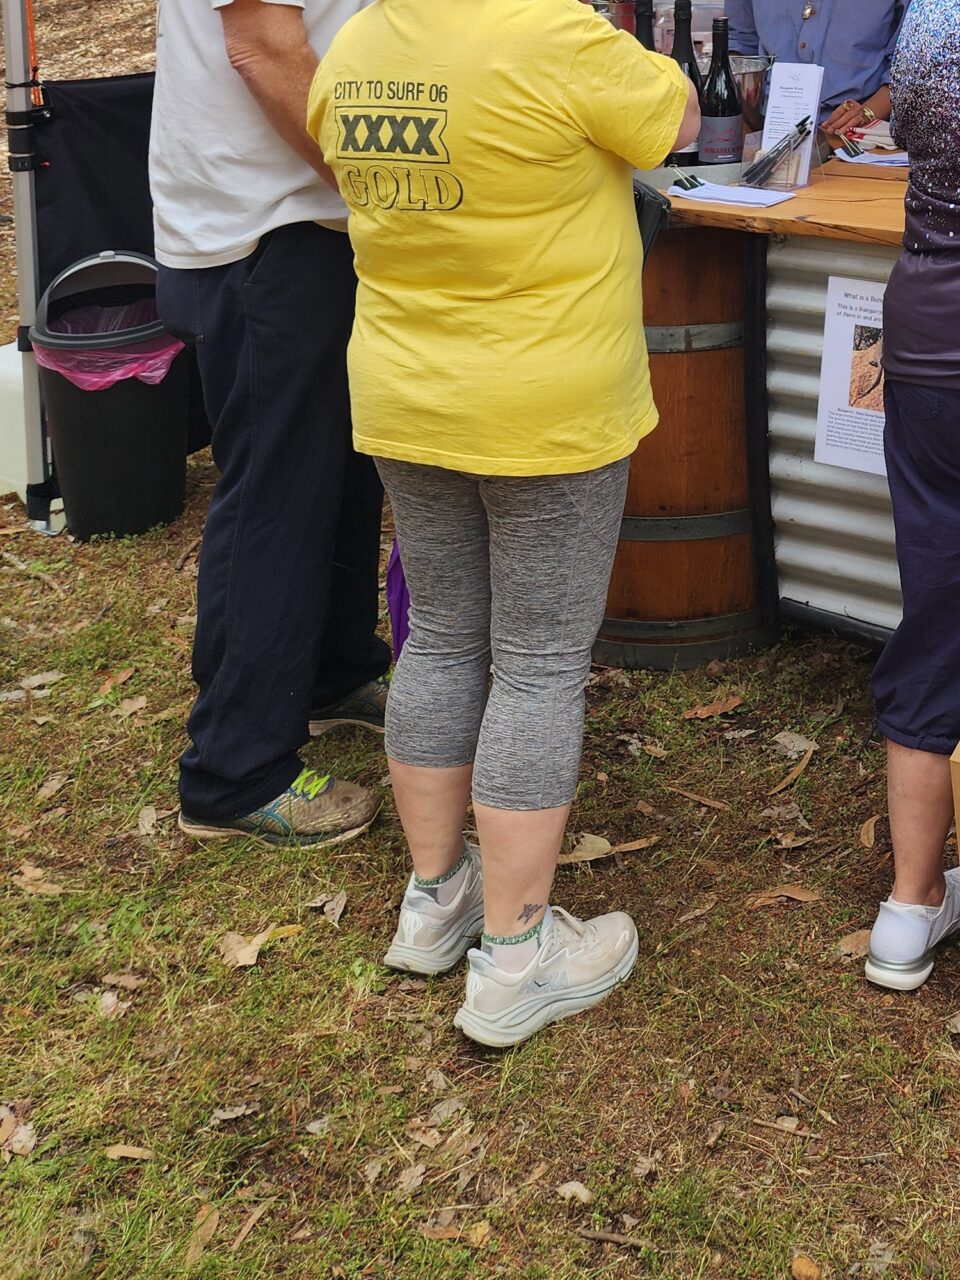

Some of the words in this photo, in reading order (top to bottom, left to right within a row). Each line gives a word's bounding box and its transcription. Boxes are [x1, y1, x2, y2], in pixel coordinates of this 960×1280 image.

[334, 80, 364, 100] CITY
[366, 80, 383, 100] TO
[387, 81, 425, 101] SURF
[429, 84, 448, 104] 06
[340, 114, 440, 156] XXXX
[342, 164, 464, 211] GOLD
[844, 292, 858, 300] What
